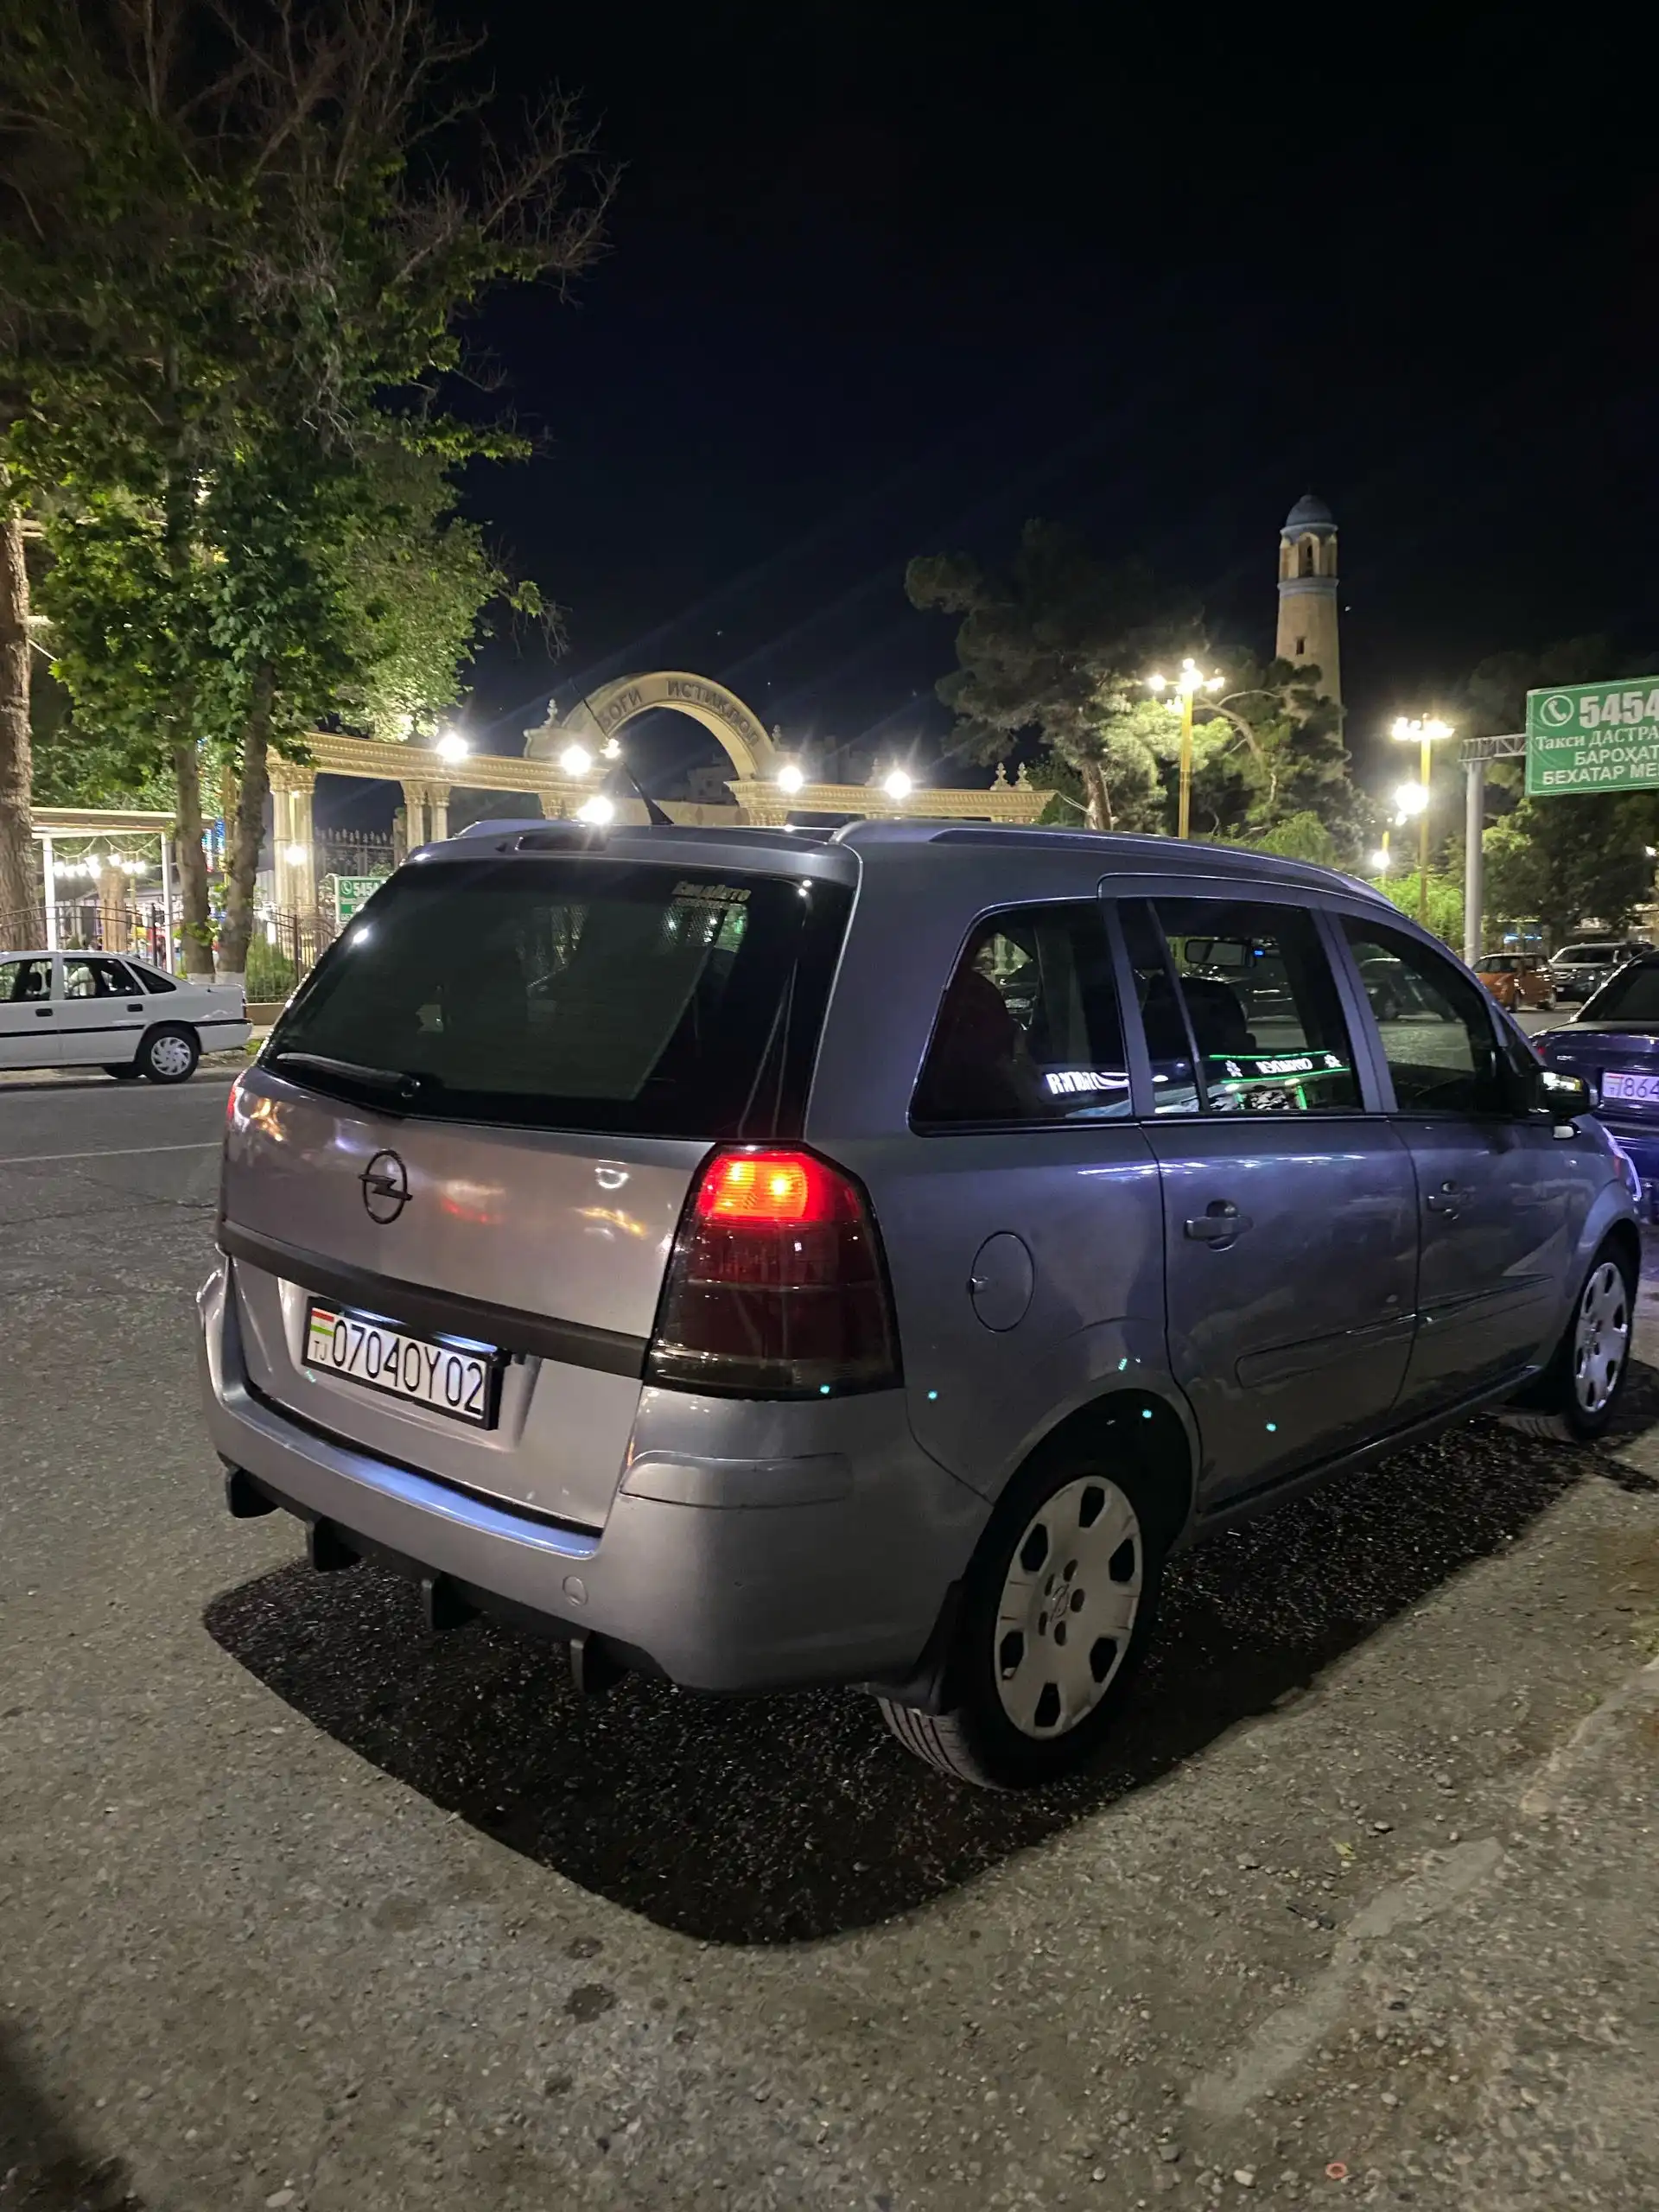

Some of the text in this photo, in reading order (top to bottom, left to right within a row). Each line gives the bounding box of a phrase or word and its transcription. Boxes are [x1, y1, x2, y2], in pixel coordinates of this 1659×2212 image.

[1535, 735, 1585, 750] Такси
[1542, 762, 1659, 785] БЕХАТАР МЕ
[313, 1340, 327, 1361] TJ
